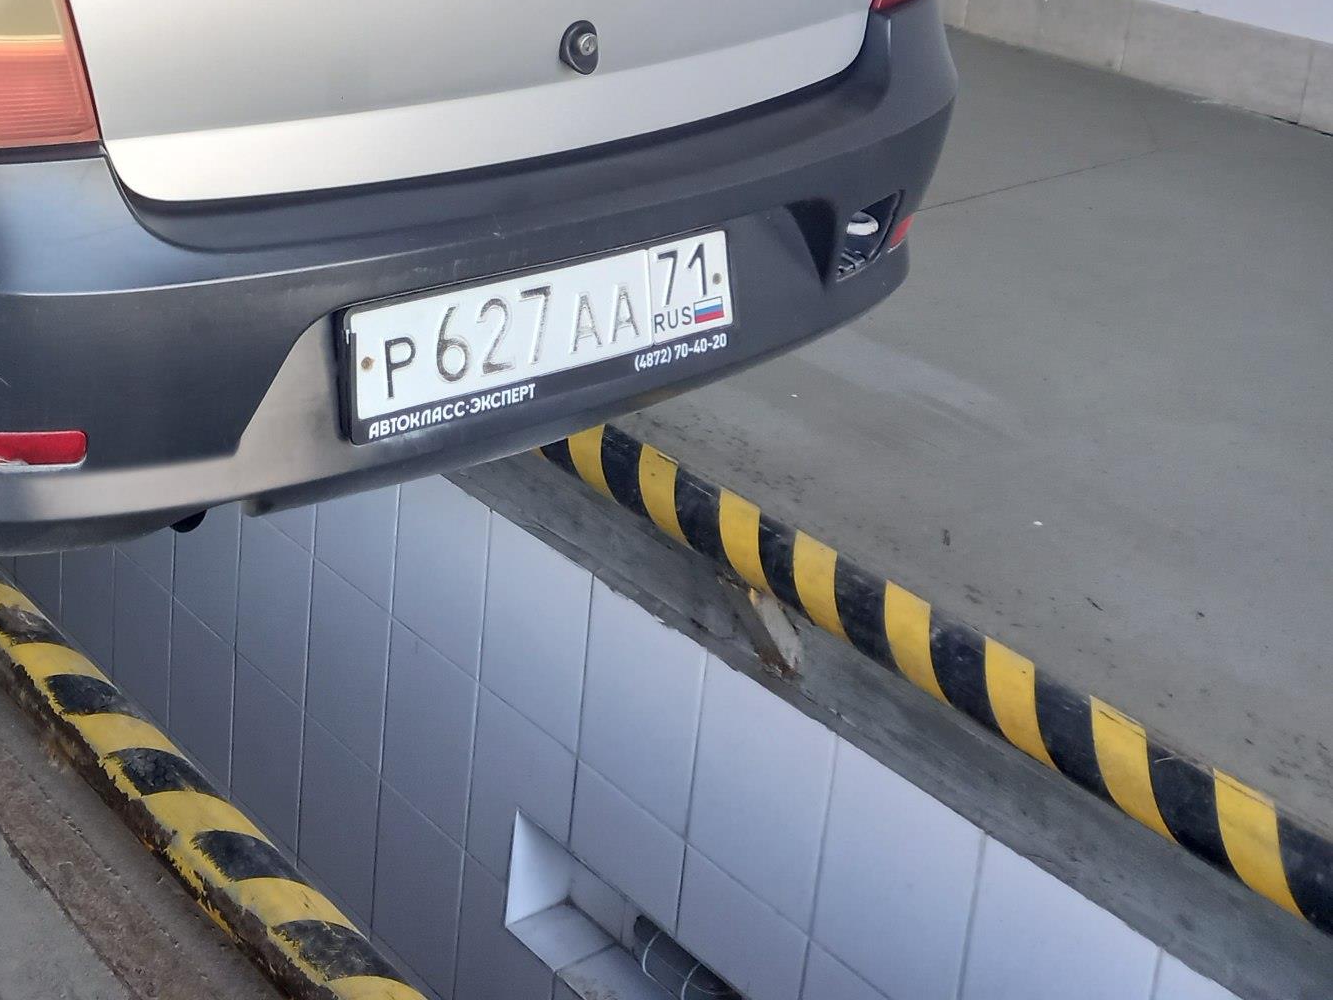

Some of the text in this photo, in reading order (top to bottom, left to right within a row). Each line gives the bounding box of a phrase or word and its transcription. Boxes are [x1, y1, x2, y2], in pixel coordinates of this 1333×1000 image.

[656, 243, 708, 307] 71
[653, 305, 693, 334] RUS
[634, 333, 728, 373] (4872) 70-40-20
